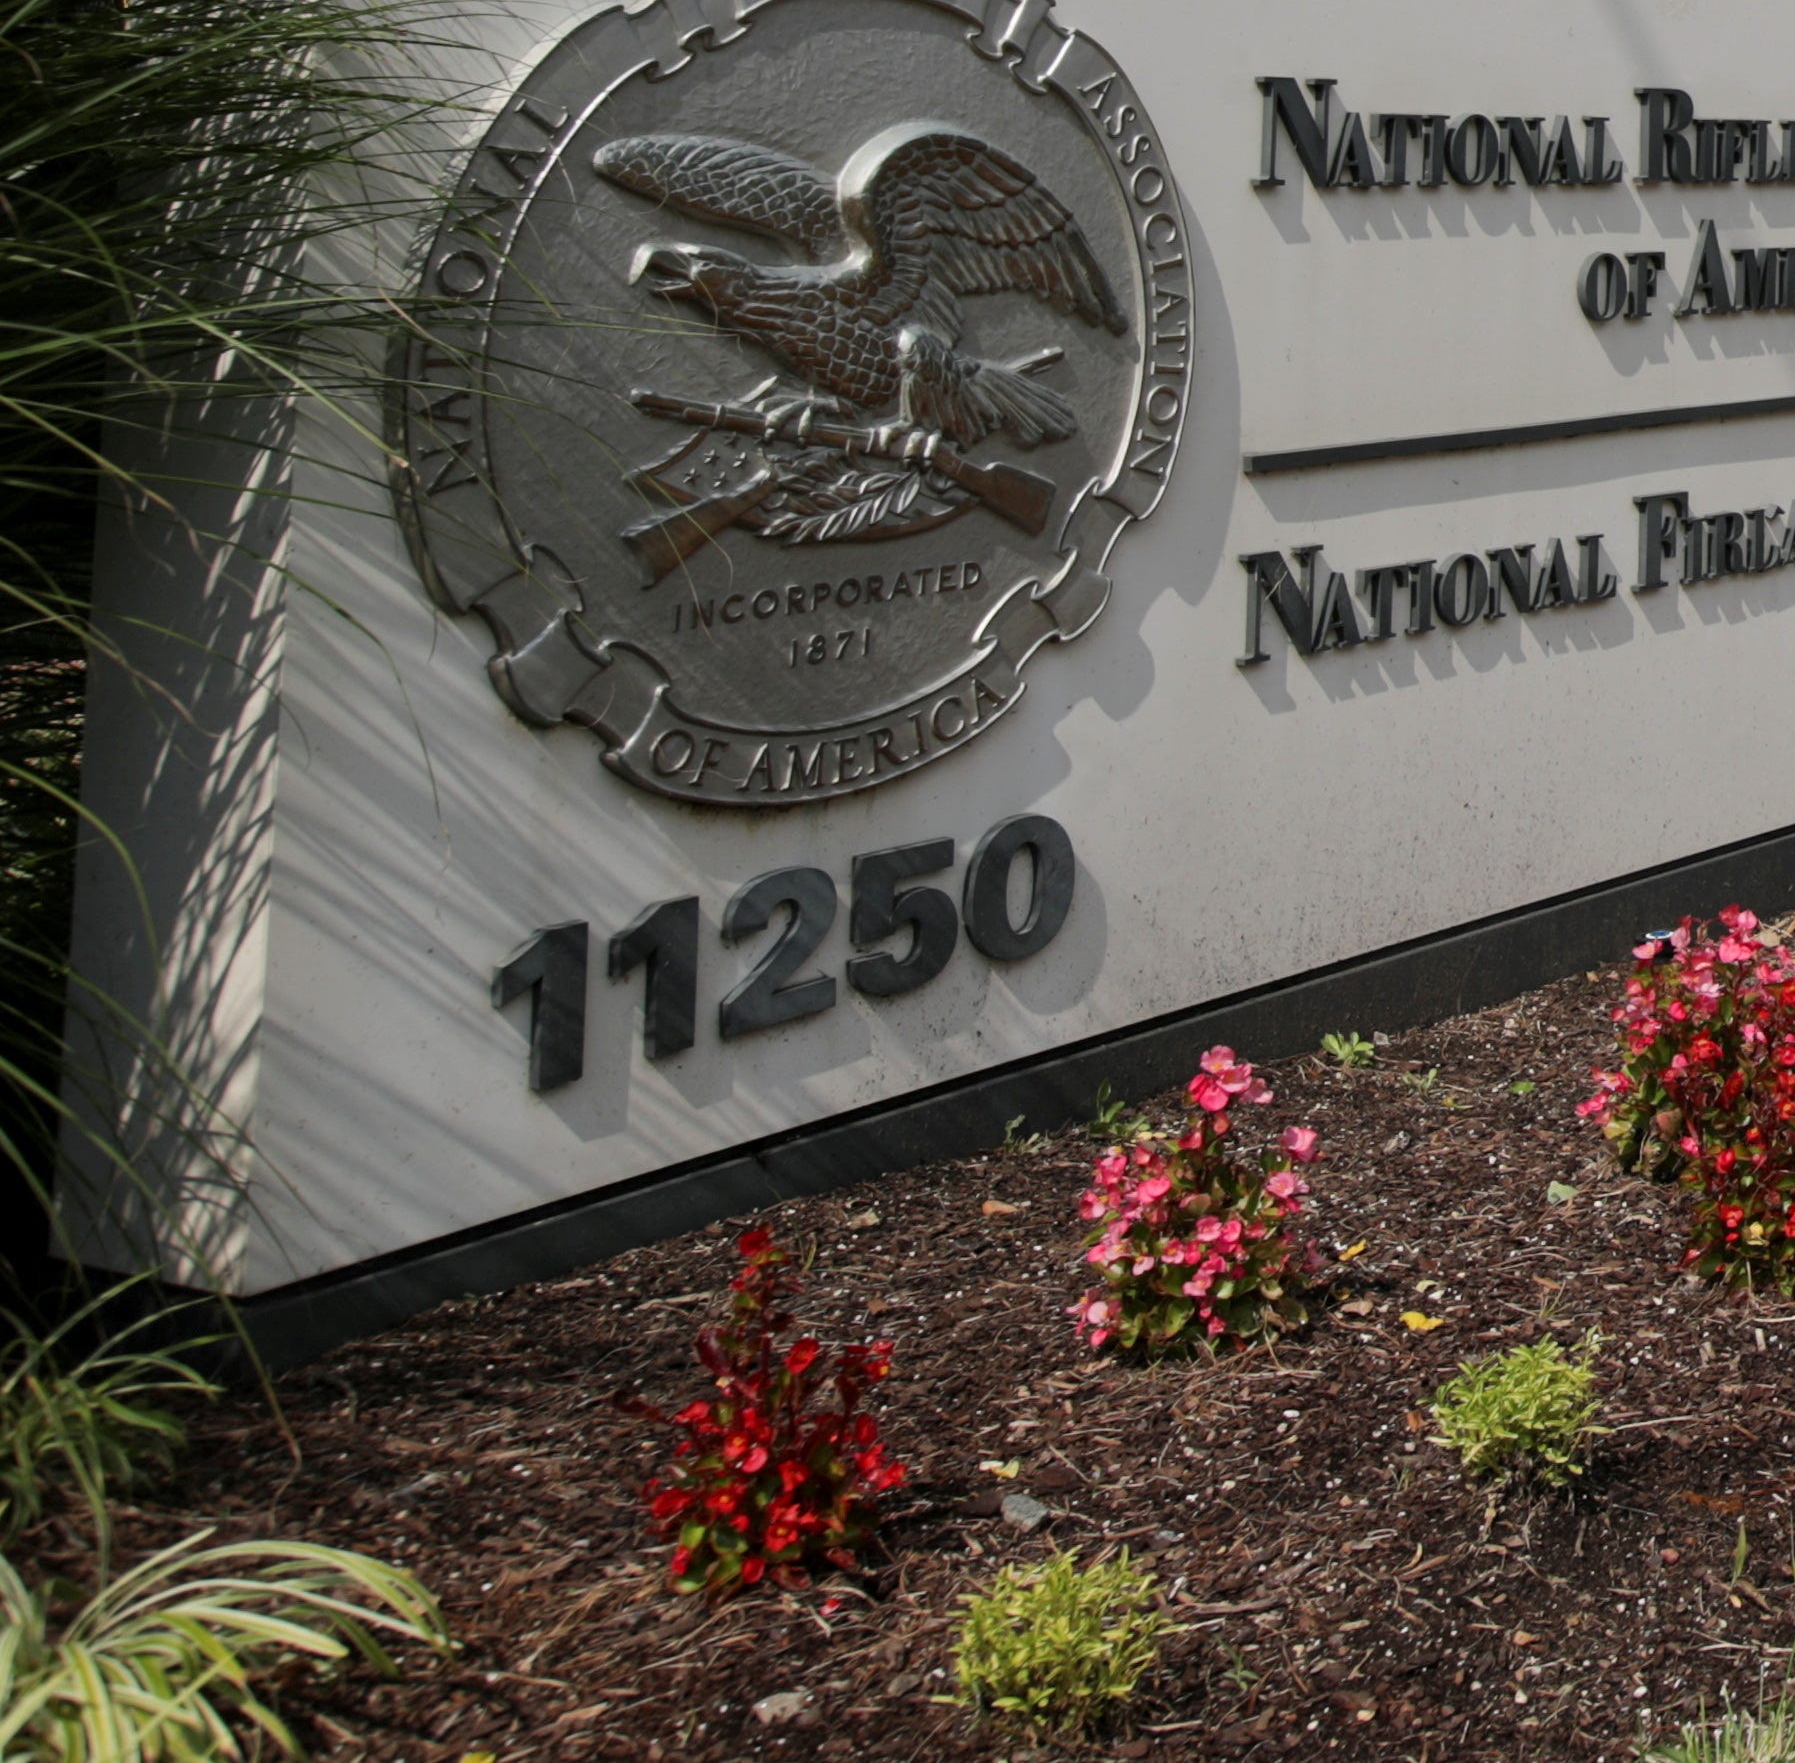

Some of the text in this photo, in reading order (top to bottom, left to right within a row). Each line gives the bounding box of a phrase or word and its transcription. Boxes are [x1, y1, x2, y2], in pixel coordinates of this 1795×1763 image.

[1251, 76, 1623, 189] NATIONAL
[1078, 72, 1187, 481] ASSOCIATION
[1577, 250, 1666, 323] OF
[672, 561, 983, 634] INCORPORATED
[788, 628, 871, 668] 1871
[1236, 533, 1617, 667] NATIONAL
[650, 675, 1006, 792] OF AMERICA
[491, 812, 1076, 1092] 11250
